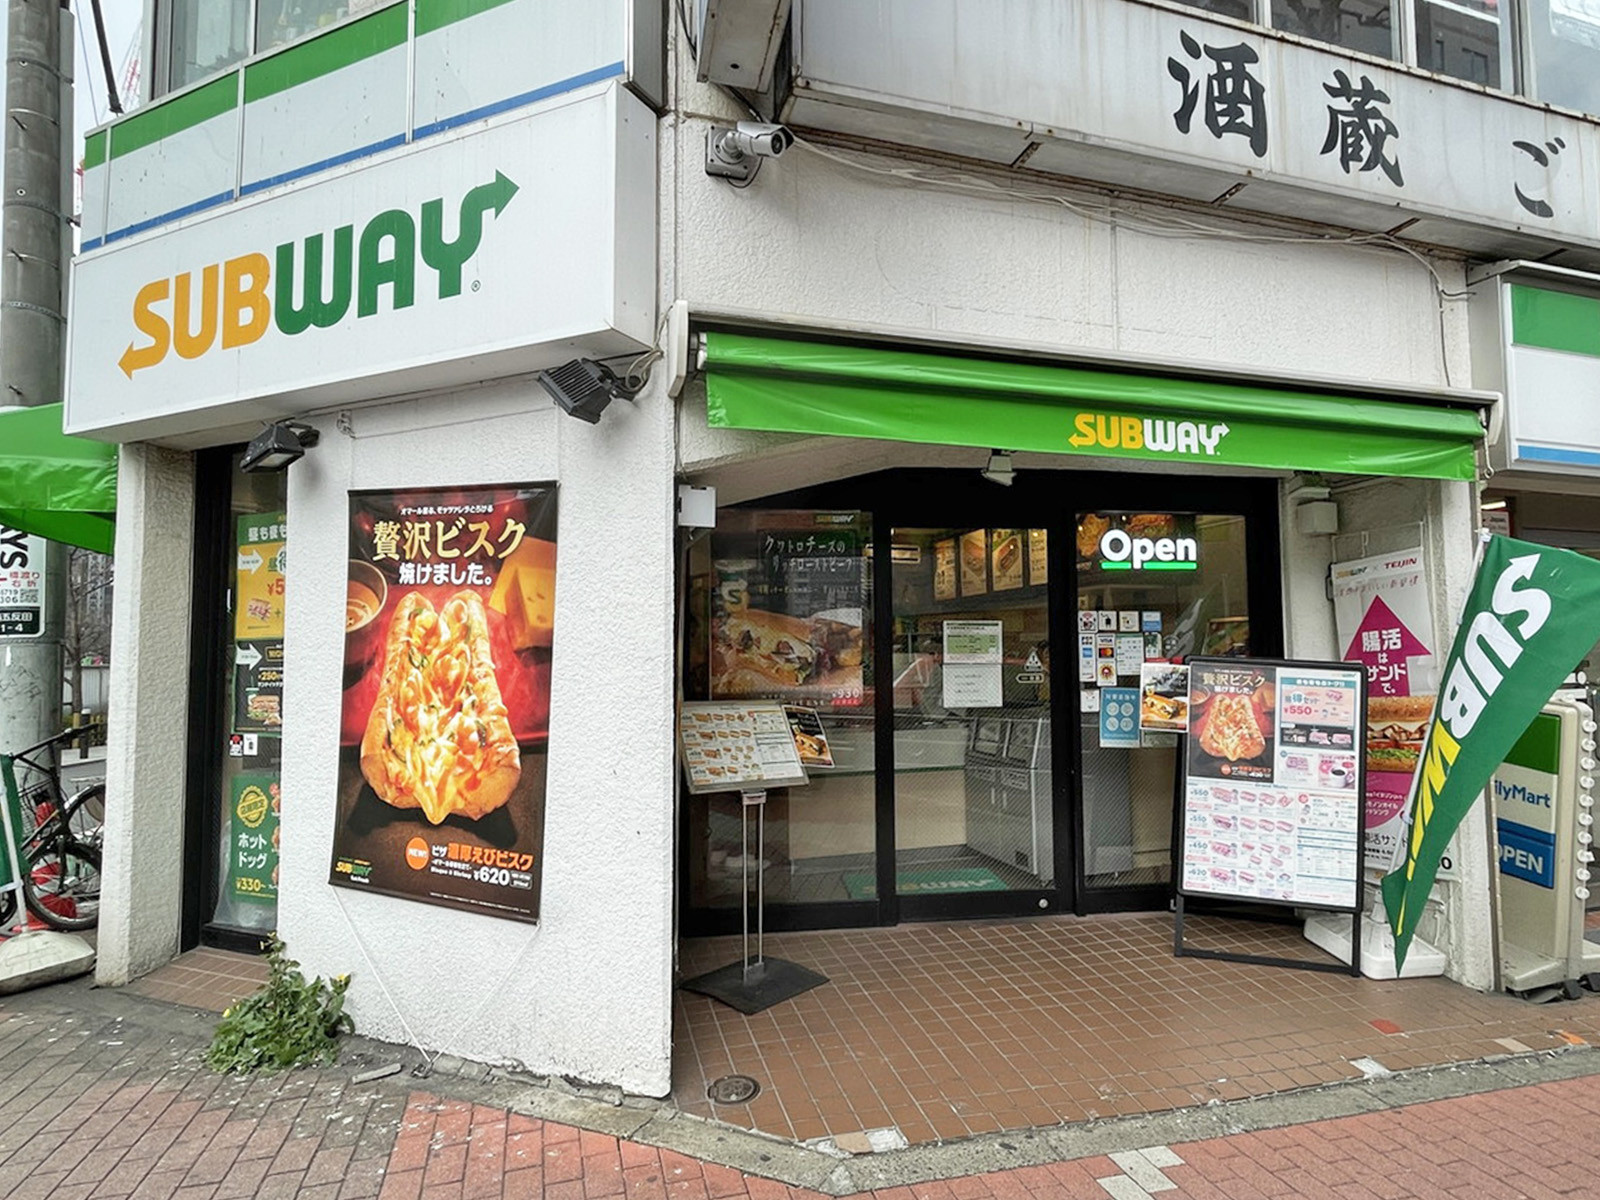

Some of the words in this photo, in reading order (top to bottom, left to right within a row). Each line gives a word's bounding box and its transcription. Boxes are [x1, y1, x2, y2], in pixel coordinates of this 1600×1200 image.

[1167, 30, 1405, 188] 酒蔵
[118, 168, 520, 379] SUBWAY
[1068, 413, 1231, 456] SUBWAY
[372, 516, 527, 562] 贅沢ビスク
[1100, 528, 1197, 570] Open
[398, 561, 493, 586] 焼けました。
[1384, 557, 1418, 569] TEIJIN
[1361, 627, 1402, 652] 腸活
[1202, 672, 1266, 687] 贅沢ビスク
[238, 851, 268, 869] ドッグ
[473, 865, 510, 887] ¥620
